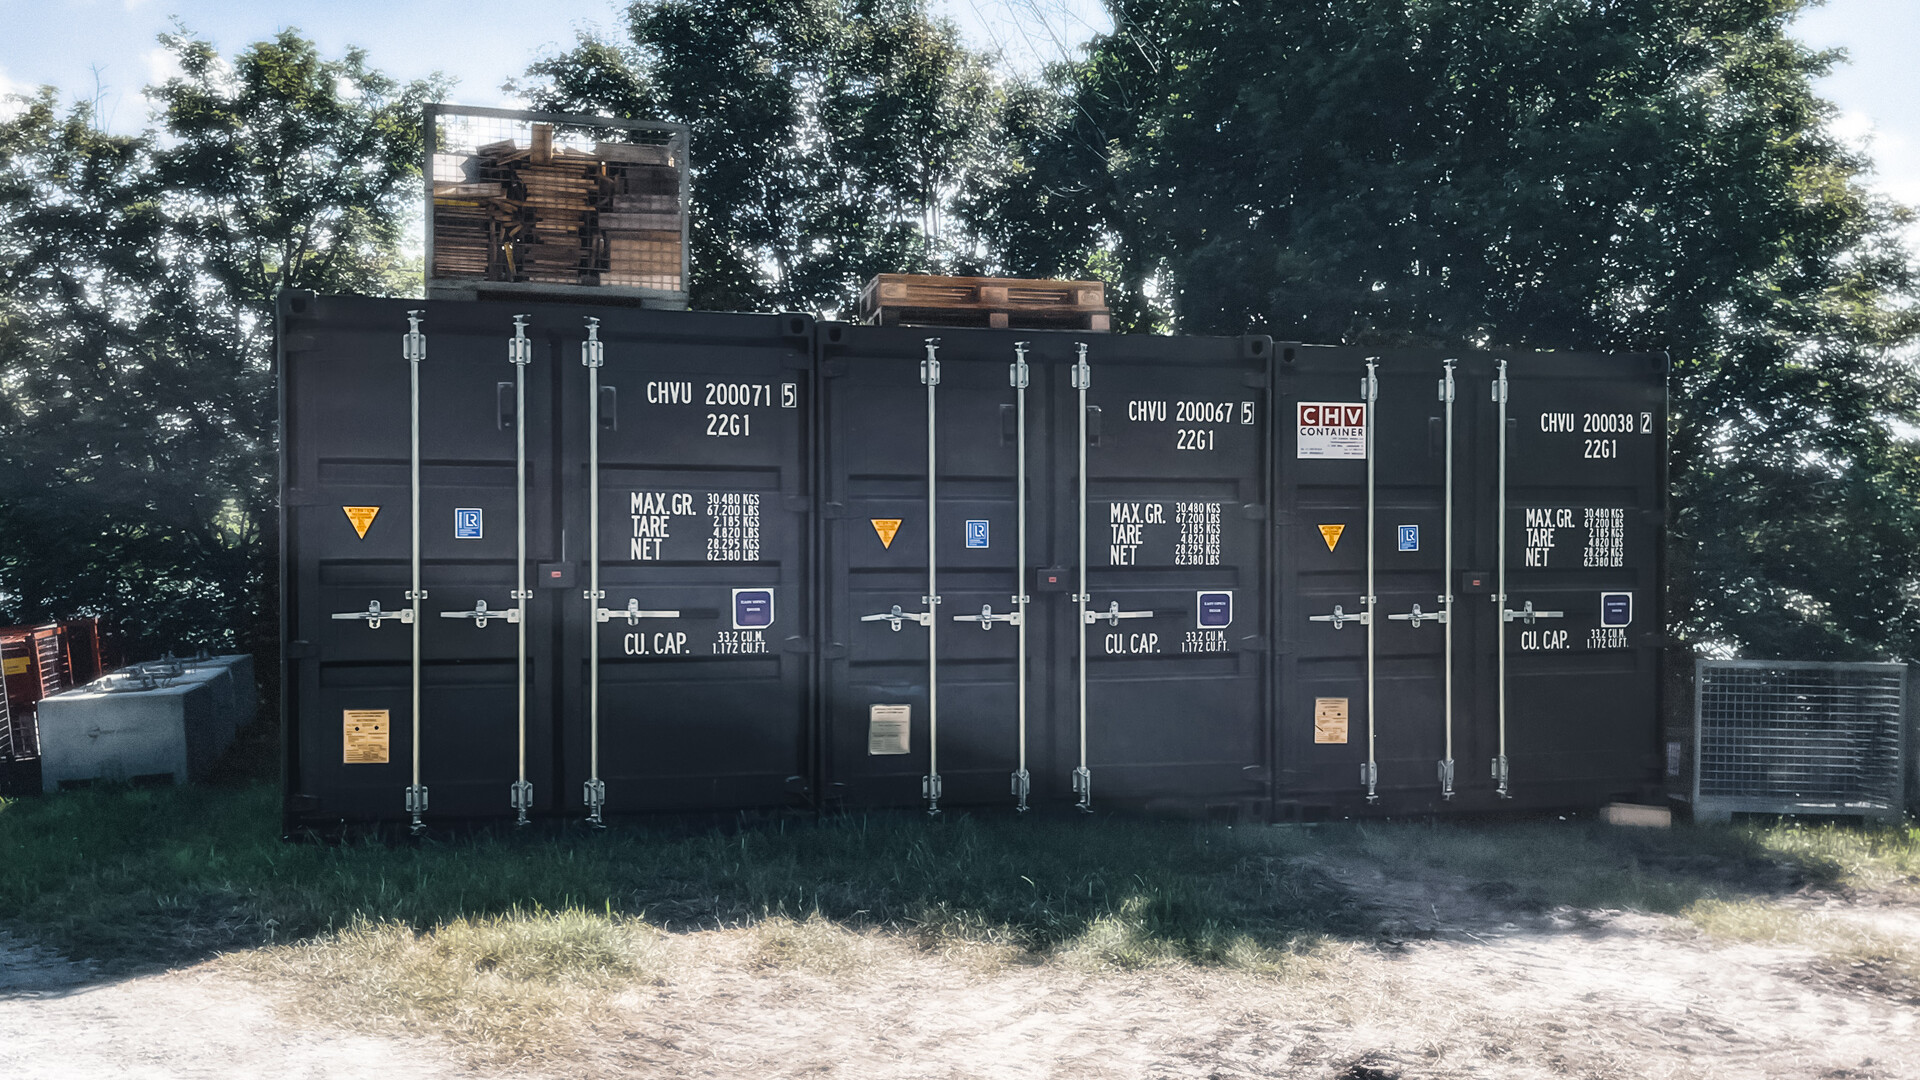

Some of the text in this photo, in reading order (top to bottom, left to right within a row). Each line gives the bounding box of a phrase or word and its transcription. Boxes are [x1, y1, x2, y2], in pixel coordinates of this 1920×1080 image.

[647, 382, 794, 406] CHVU 200071 5
[1129, 401, 1253, 423] CHVU 200067 5
[1303, 408, 1361, 424] CHV
[707, 414, 749, 436] 22G1
[1541, 413, 1651, 433] CHVU 200038 2
[1177, 429, 1213, 450] 22G1
[1300, 428, 1363, 436] CONTAINER
[1585, 440, 1616, 458] 22G1
[707, 494, 759, 505] 30.480 KGS
[707, 505, 759, 516] 67.200 LBS
[1176, 503, 1220, 513] 30.480 KGS
[713, 517, 759, 527] 2.185 KGS
[1176, 513, 1220, 523] 67.200 LBS
[632, 516, 669, 537] TARE
[713, 528, 759, 538] 4.820 LBS
[1111, 524, 1143, 544] TARE
[1181, 524, 1220, 534] 2.185 KGS
[707, 539, 759, 549] 28.295 KGS
[1181, 535, 1220, 544] 4.820 LBS
[1526, 528, 1554, 547] TARE
[631, 539, 662, 560] NET
[707, 550, 759, 561] 62.380 LBS
[1110, 545, 1137, 565] NET
[1175, 545, 1220, 554] 28.295 KGS
[1526, 548, 1549, 567] NET
[1175, 555, 1220, 565] 62.380 LBS
[624, 633, 690, 655] CU. CAP.
[718, 632, 738, 642] 33.2
[1106, 634, 1160, 654] CU. CAP.
[1186, 631, 1203, 642] 33.2
[1521, 631, 1570, 650] CU. CAP.
